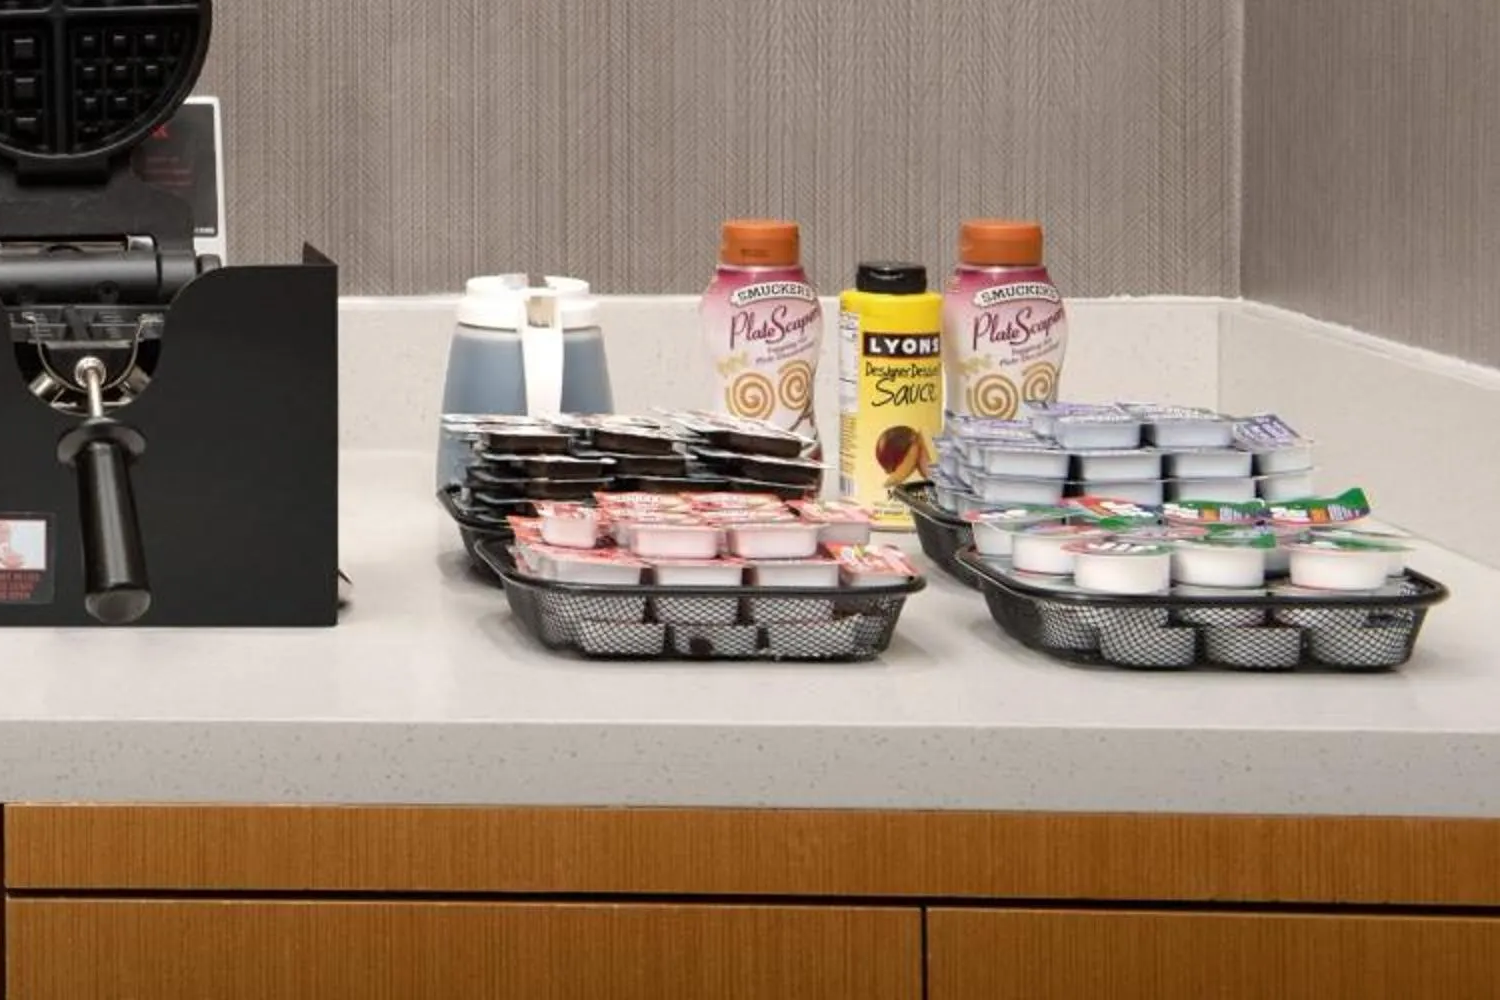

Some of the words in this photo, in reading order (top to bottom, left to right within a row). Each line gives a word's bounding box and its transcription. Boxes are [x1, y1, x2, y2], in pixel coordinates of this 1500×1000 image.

[869, 337, 939, 354] LYONS
[866, 361, 911, 382] Designer
[871, 377, 938, 406] Sauce
